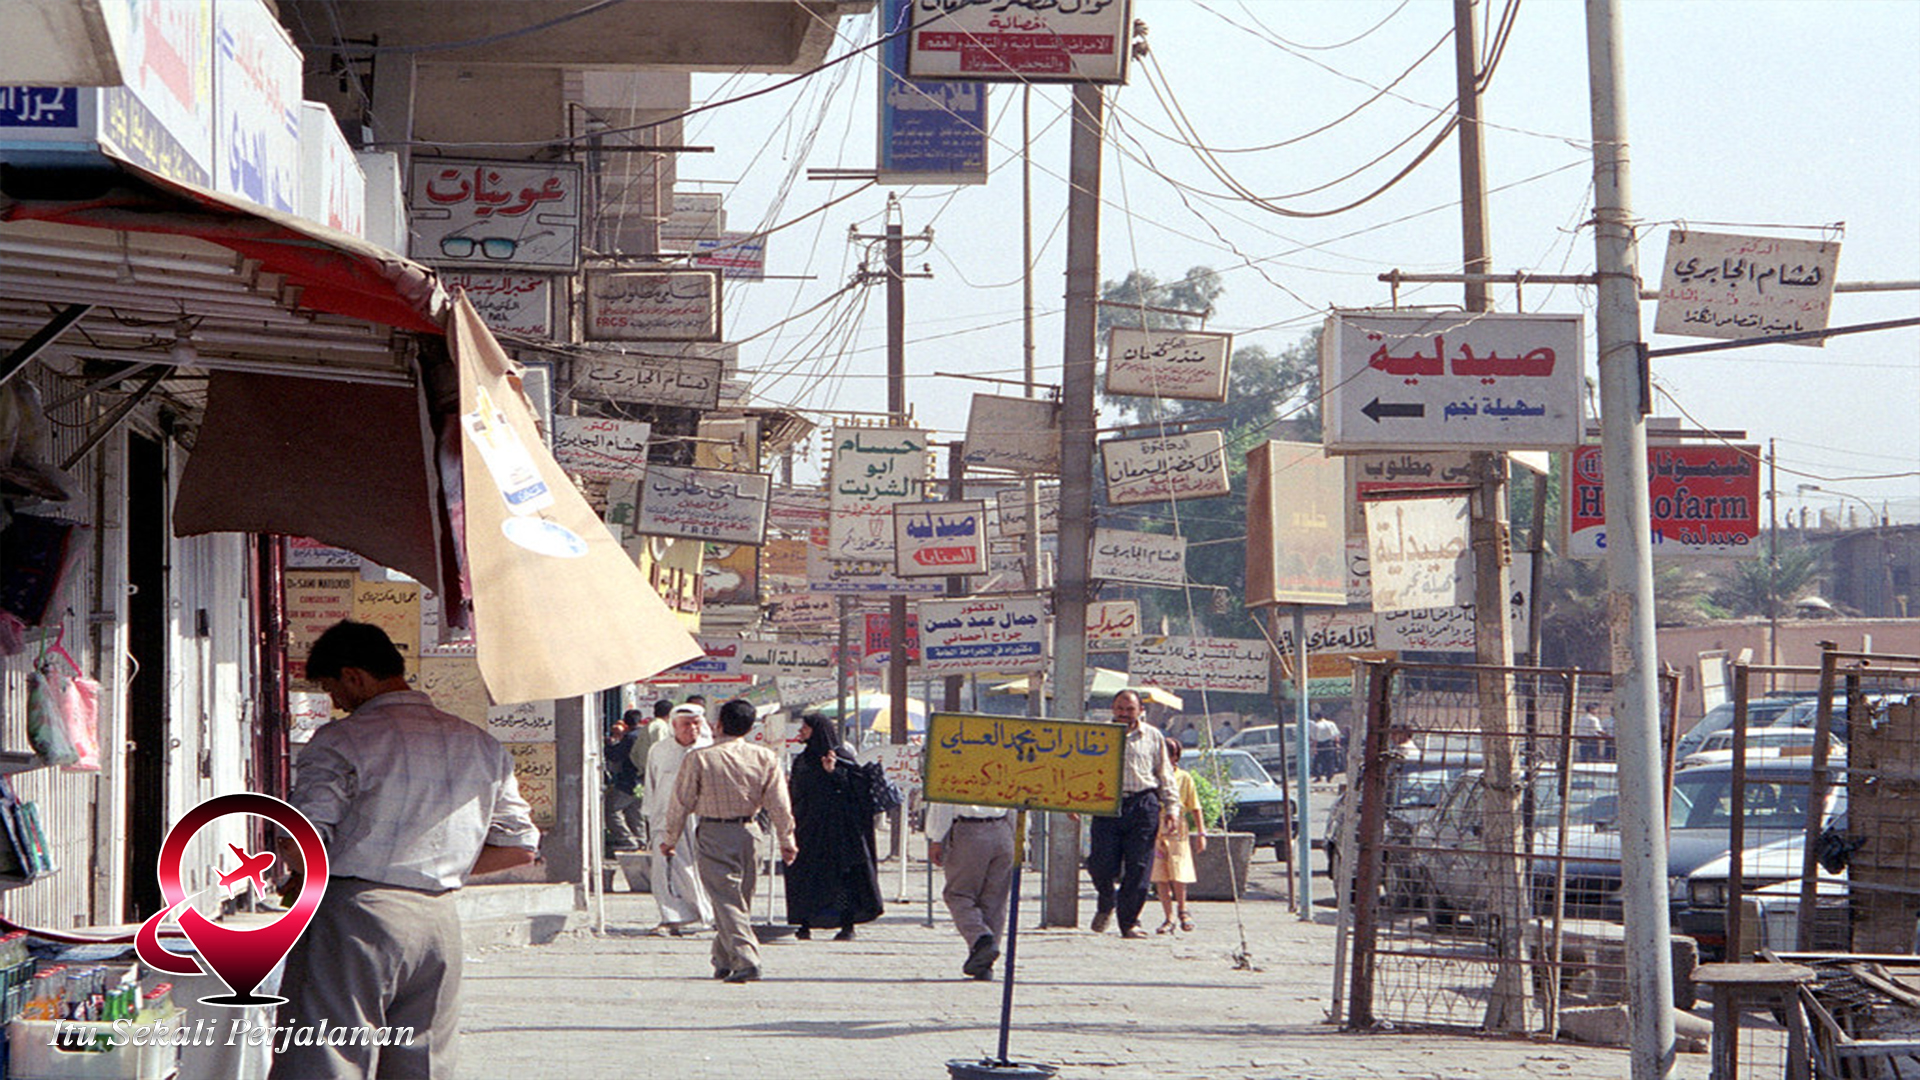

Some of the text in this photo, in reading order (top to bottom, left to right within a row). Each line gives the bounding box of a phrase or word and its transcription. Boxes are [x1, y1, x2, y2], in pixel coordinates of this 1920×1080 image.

[426, 168, 564, 216] عوينات
[1674, 258, 1822, 294] هشام الجابري
[596, 316, 628, 327] FRCS
[1368, 334, 1556, 386] صيدلية
[1444, 396, 1546, 422] سهيلة نجم
[838, 432, 923, 461] حسام
[864, 457, 894, 480] ابو
[1578, 486, 1749, 519] Hofarm
[1375, 505, 1467, 575] صيدلية
[925, 611, 1038, 633] جمال عبد حسن
[777, 650, 830, 672] صيدلية
[1035, 728, 1109, 758] نظارات
